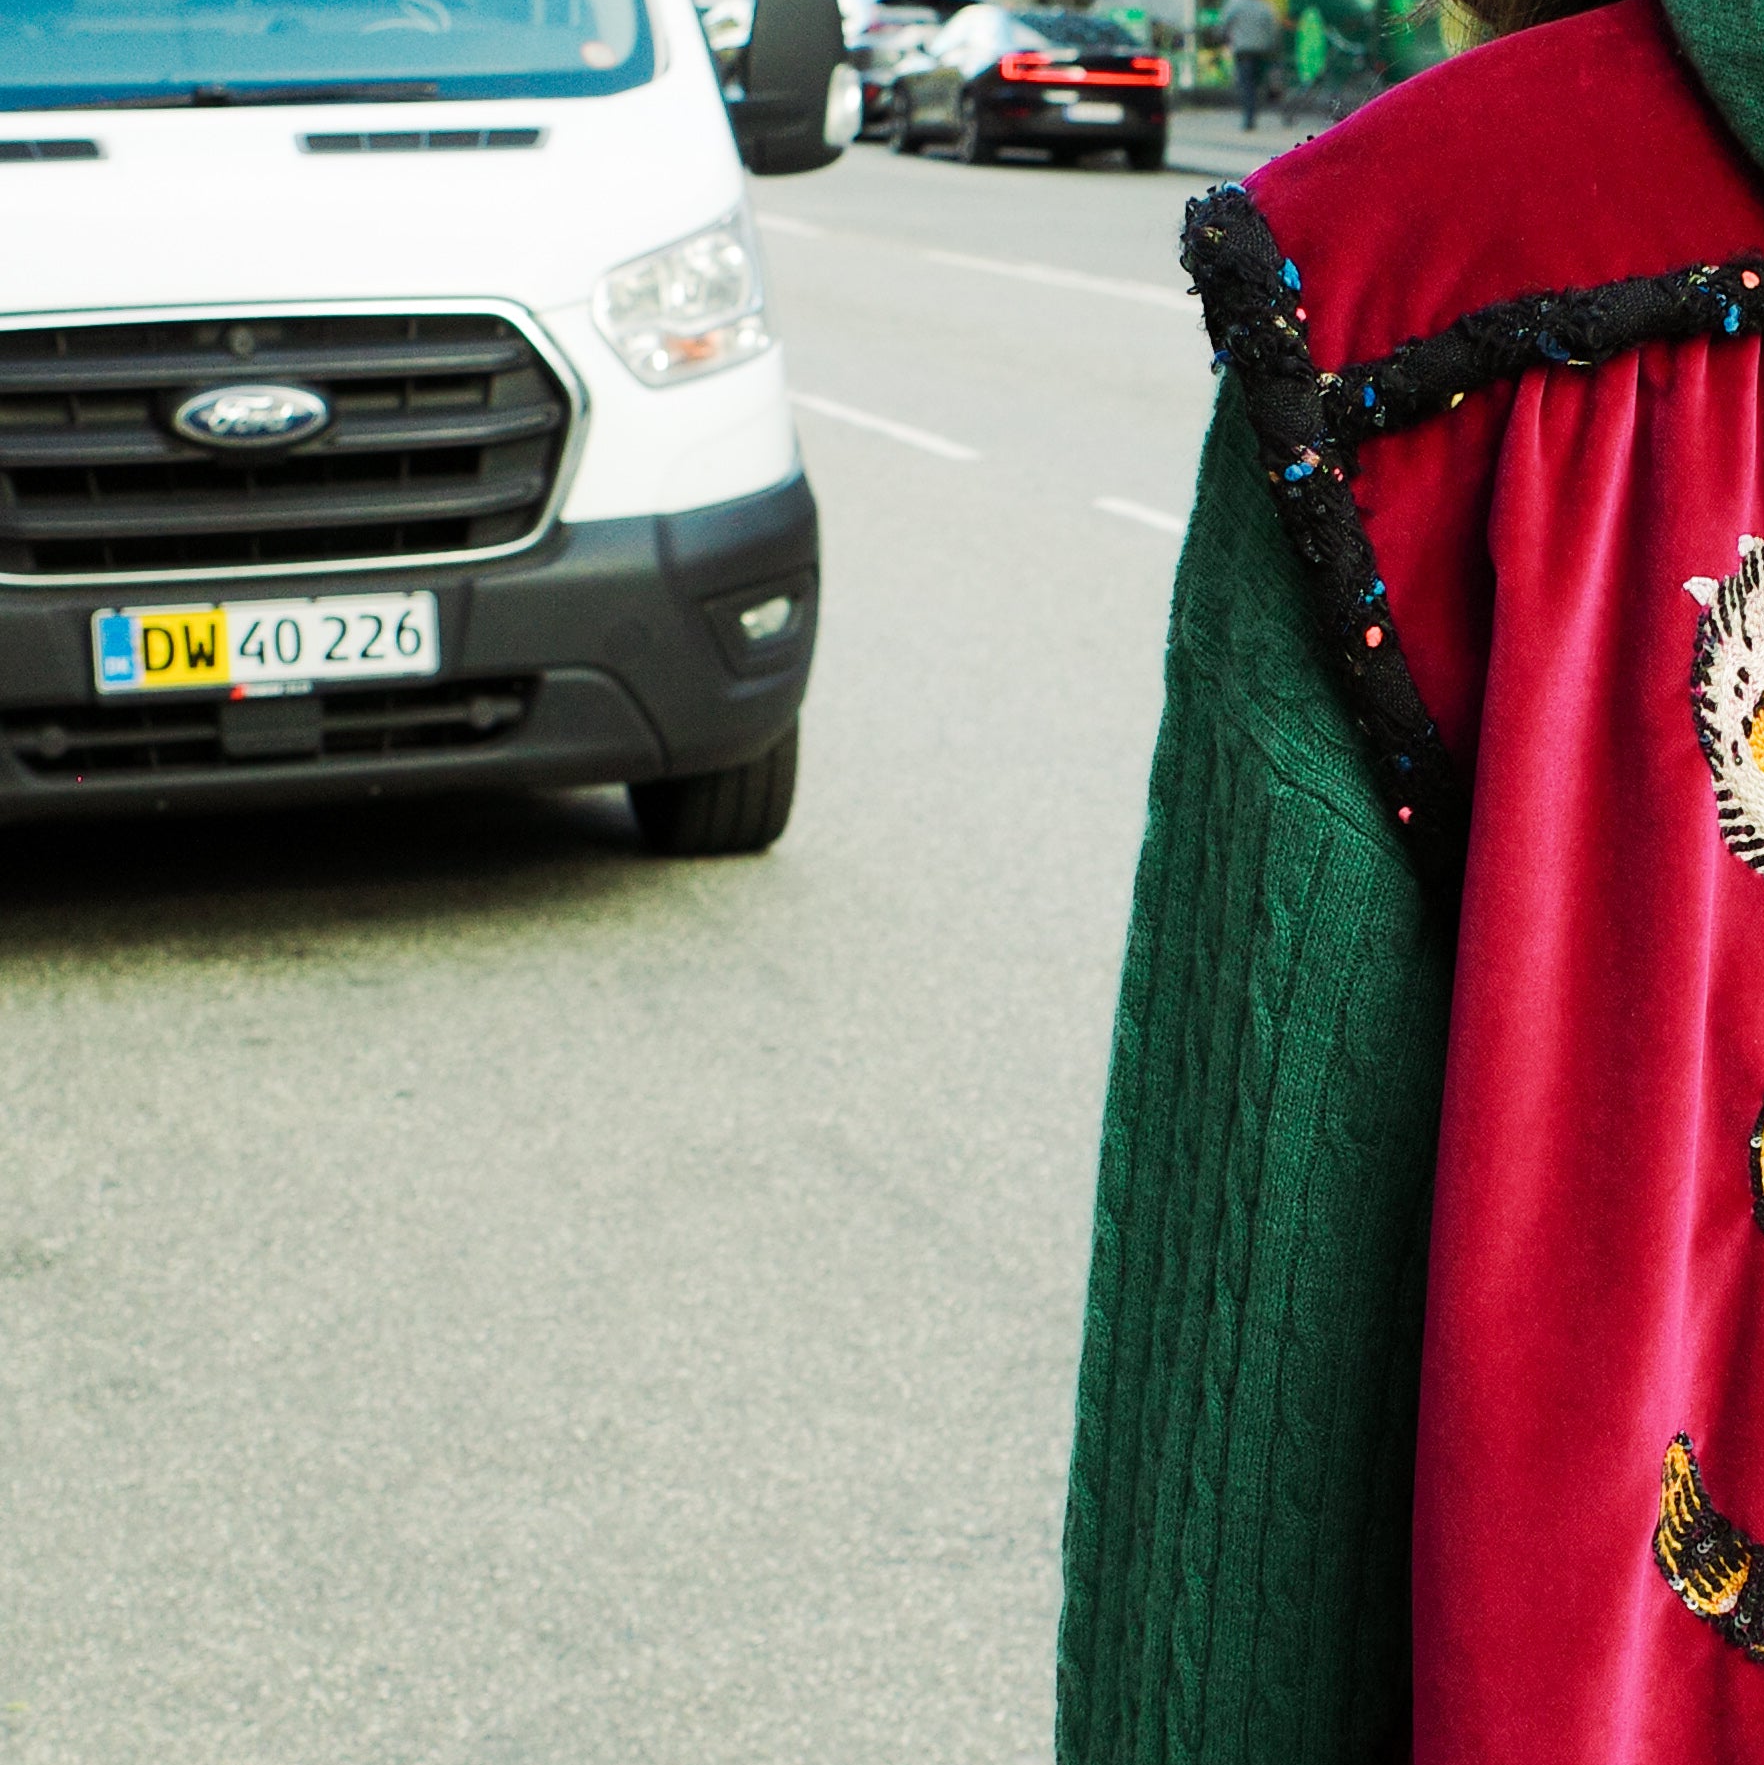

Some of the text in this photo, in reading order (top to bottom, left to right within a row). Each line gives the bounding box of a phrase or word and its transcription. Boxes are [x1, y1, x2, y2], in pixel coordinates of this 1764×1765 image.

[142, 623, 217, 672] DW
[239, 618, 303, 666] 40
[322, 610, 422, 662] 226
